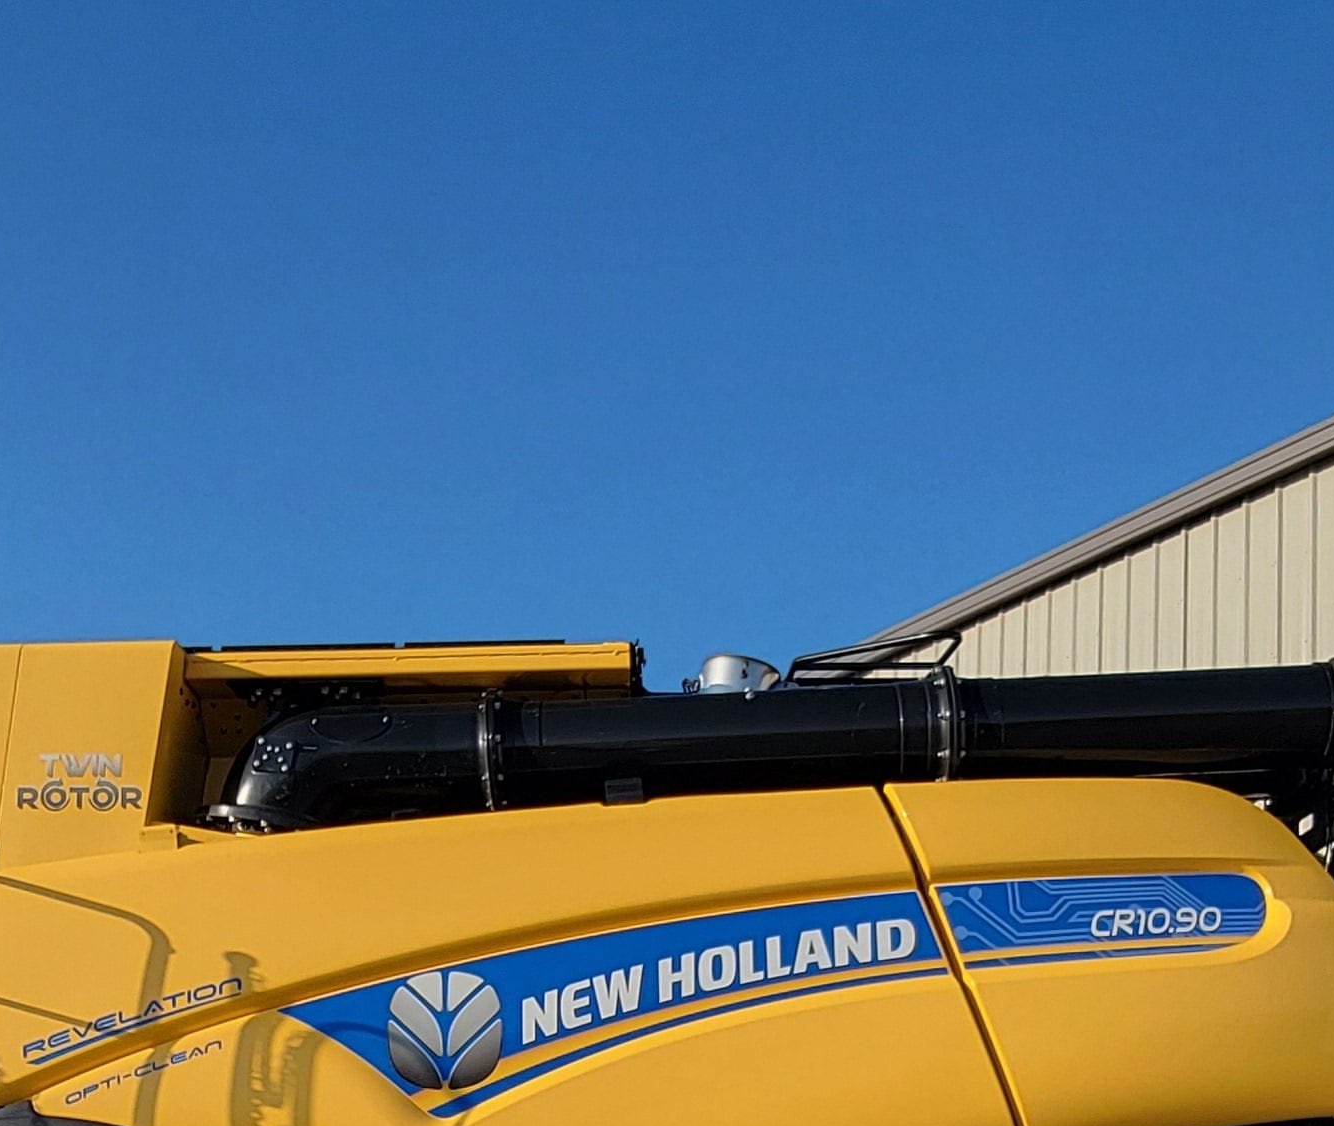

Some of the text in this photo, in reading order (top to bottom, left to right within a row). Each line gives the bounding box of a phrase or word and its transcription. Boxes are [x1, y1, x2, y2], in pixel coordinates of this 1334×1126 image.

[40, 753, 123, 777] TWIN
[16, 778, 143, 811] ROTOR
[1090, 906, 1222, 937] CR10.90
[522, 918, 917, 1044] NEW HOLLAND
[22, 977, 243, 1059] REVELATION
[65, 1039, 223, 1105] OPTI-CLEAN
